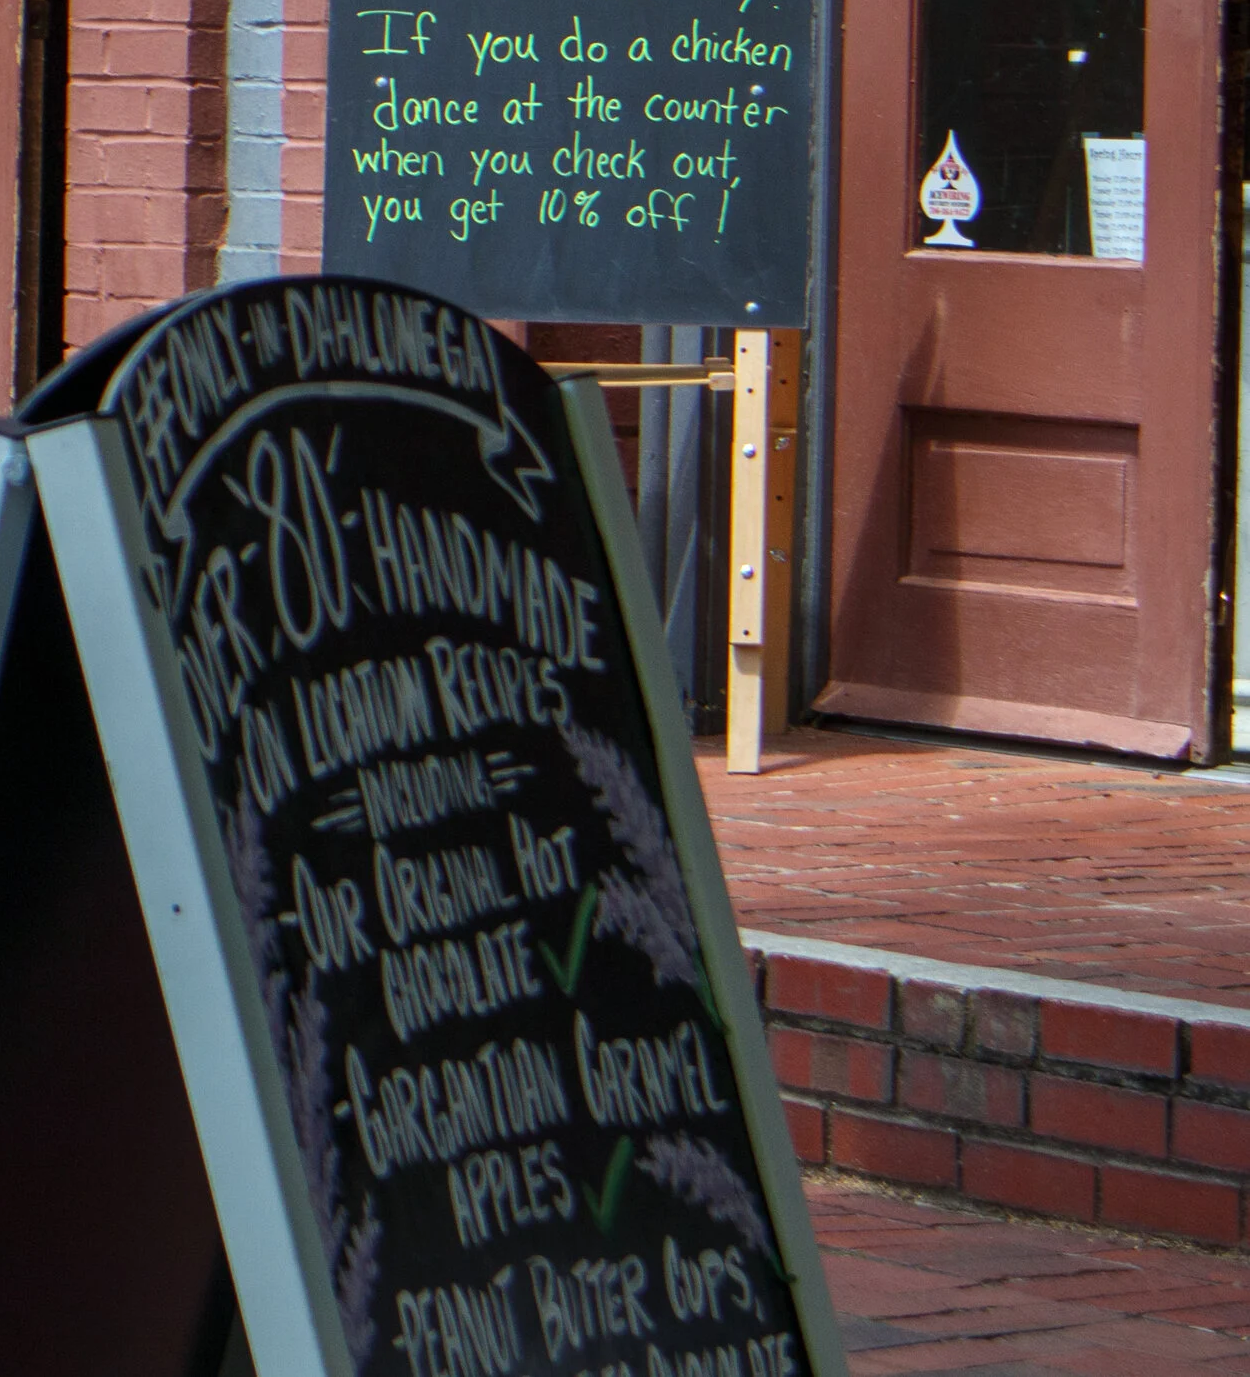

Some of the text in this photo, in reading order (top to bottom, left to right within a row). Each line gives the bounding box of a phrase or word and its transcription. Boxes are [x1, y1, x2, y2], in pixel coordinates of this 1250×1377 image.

[357, 10, 793, 76] If you do a chicken
[373, 75, 789, 131] dance at the counter
[352, 138, 444, 177] when
[470, 147, 534, 186] you
[552, 130, 646, 180] check
[363, 193, 423, 242] you
[450, 189, 504, 241] get
[539, 189, 600, 228] 10%
[241, 635, 570, 816] ON LOCATION RECIPES
[374, 841, 519, 947] ORIGINAL
[508, 811, 579, 901] HOT
[381, 919, 544, 1045] CHOCOLATE
[574, 1007, 730, 1126] CARAMEL
[448, 1140, 576, 1249] APPLES
[527, 1253, 655, 1363] BUTTER
